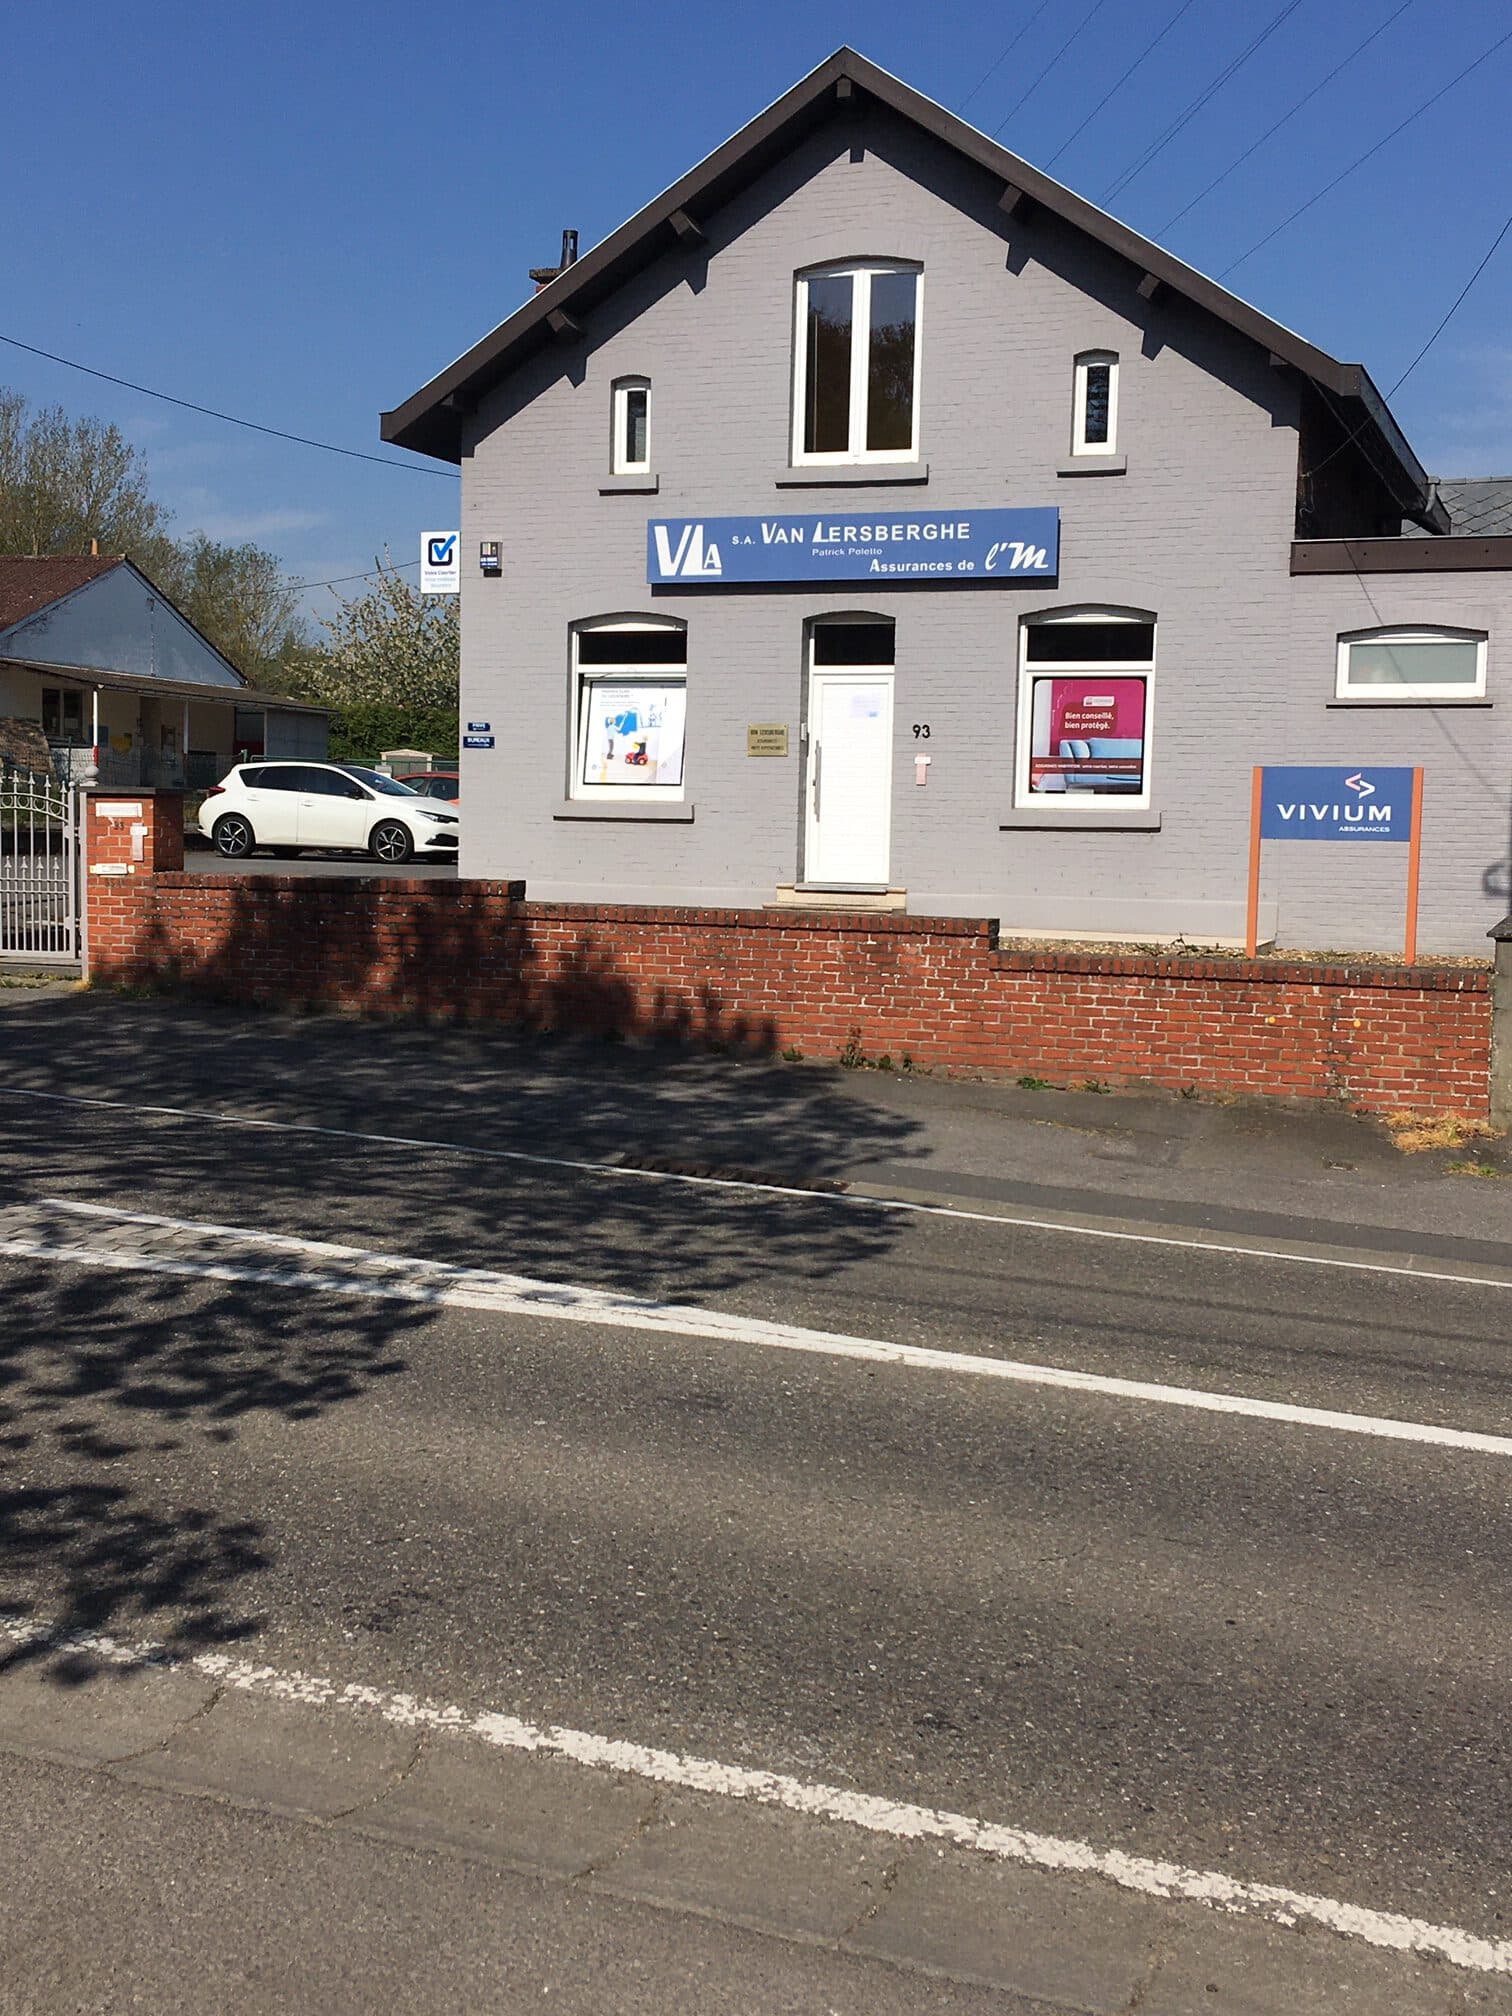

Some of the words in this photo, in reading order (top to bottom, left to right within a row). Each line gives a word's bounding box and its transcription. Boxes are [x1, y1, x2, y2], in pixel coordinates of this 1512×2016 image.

[732, 535, 756, 545] S.A.
[761, 522, 804, 544] VAN
[812, 521, 970, 543] LERSBERGHE
[812, 548, 845, 556] Patrick
[869, 558, 953, 572] Assurances
[957, 560, 975, 571] de
[912, 724, 931, 739] 93
[1081, 722, 1111, 731] protégé.
[1277, 804, 1391, 821] VIVIUM
